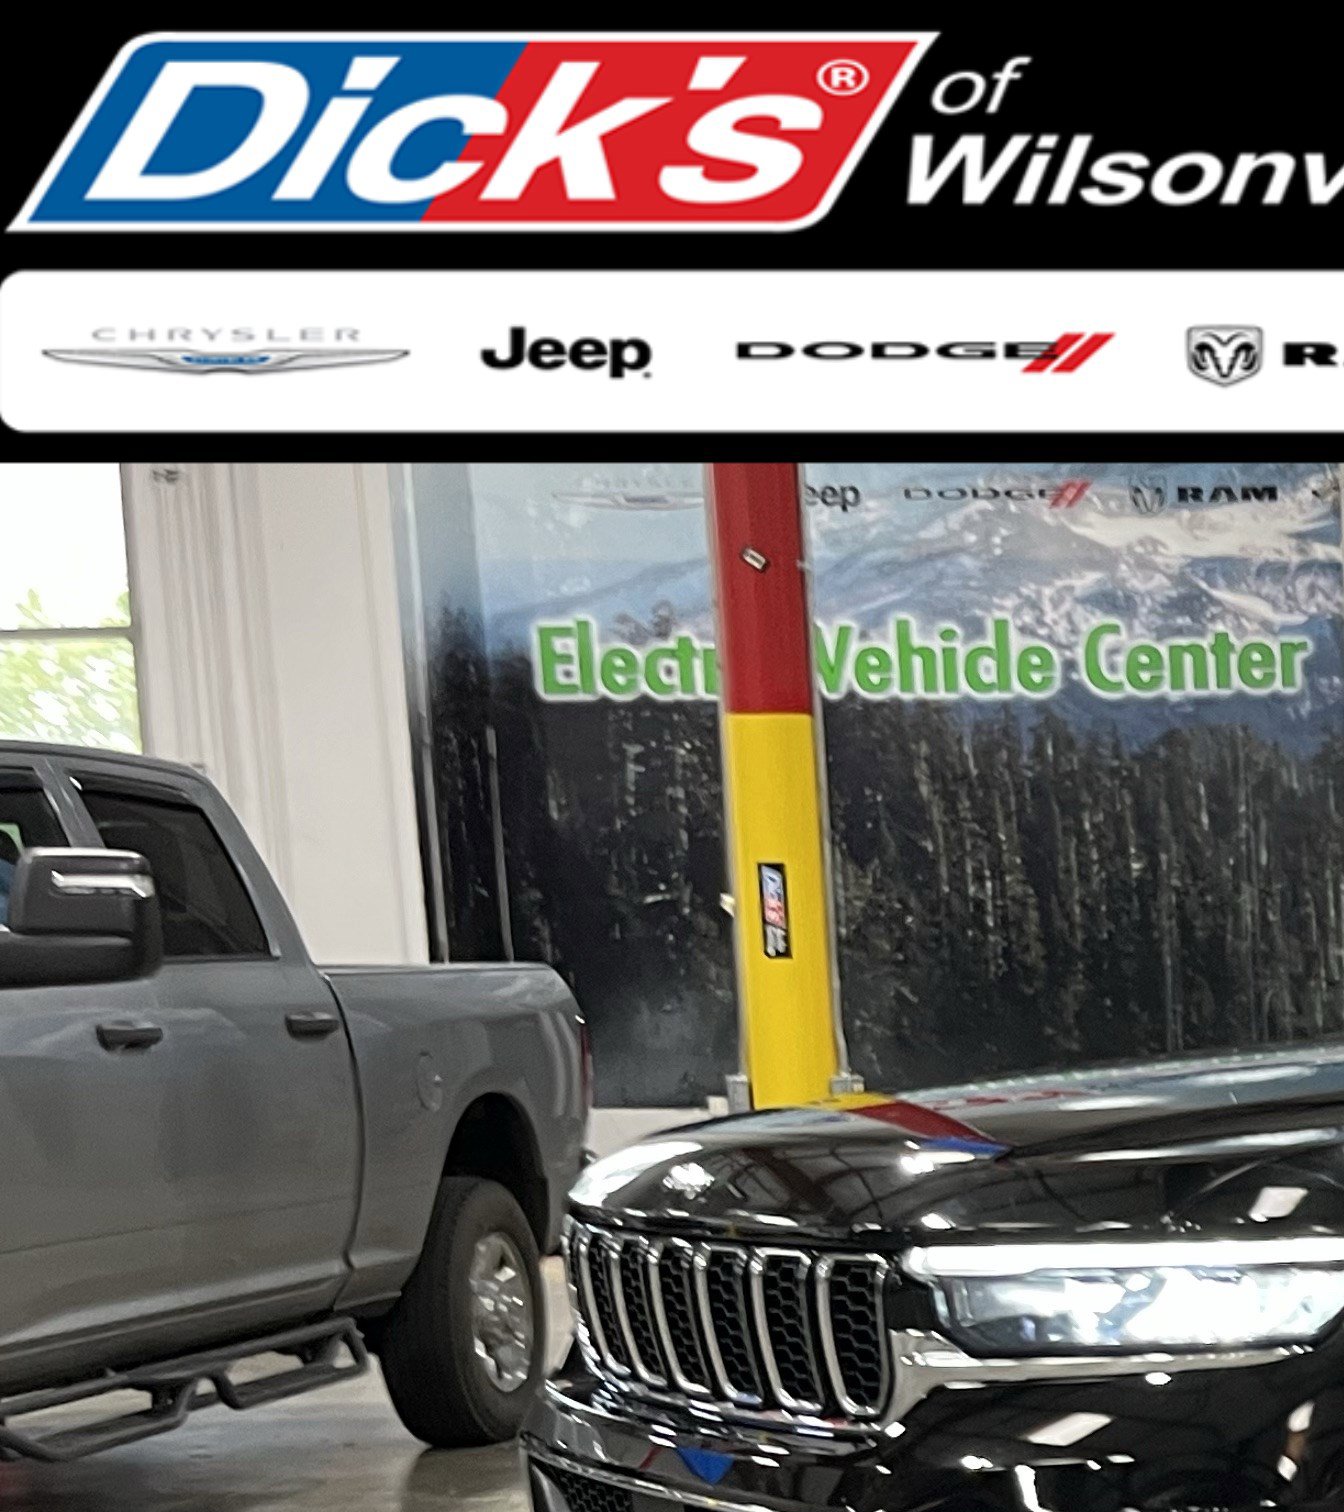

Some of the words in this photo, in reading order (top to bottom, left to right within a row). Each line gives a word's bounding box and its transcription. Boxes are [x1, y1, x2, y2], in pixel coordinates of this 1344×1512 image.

[803, 484, 862, 512] eep
[1176, 485, 1279, 503] RAM
[813, 618, 1056, 694] Vehicle
[1084, 623, 1309, 692] Center
